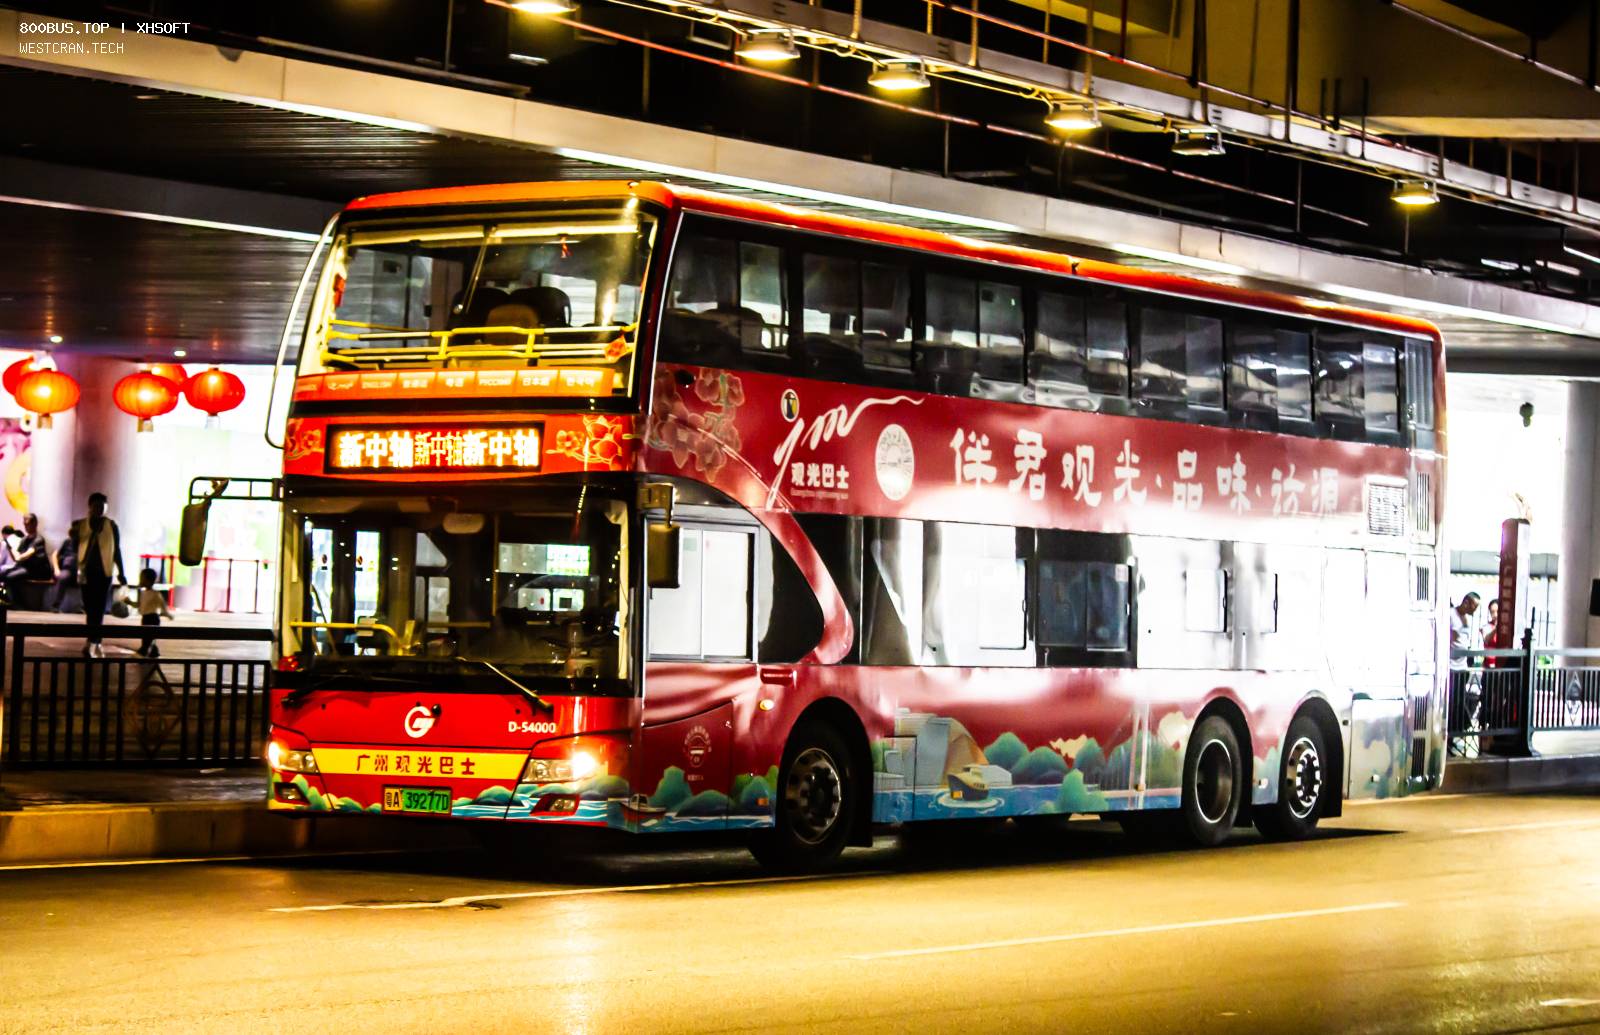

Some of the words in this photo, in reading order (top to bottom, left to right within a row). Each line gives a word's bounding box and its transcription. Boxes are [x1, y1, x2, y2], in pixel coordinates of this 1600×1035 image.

[791, 462, 850, 490] 观光巴士
[508, 721, 556, 734] D-54000
[356, 754, 476, 775] 广州观光巴士
